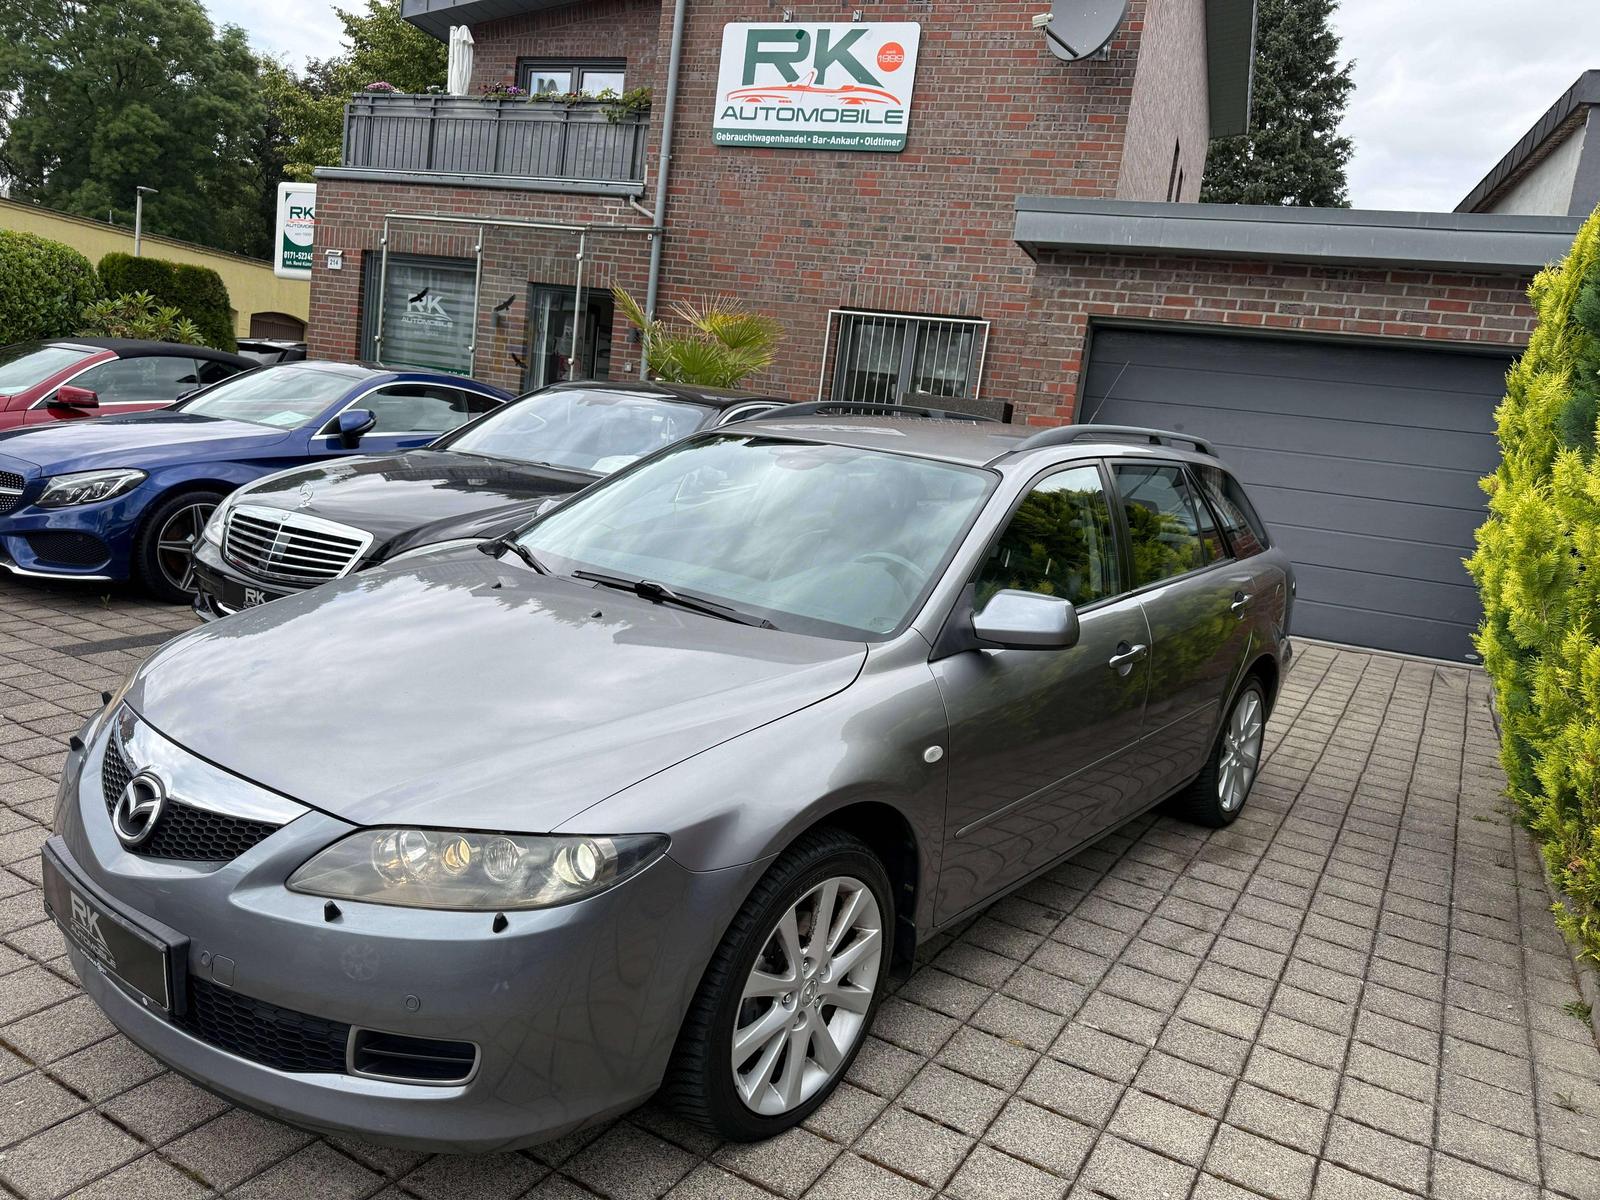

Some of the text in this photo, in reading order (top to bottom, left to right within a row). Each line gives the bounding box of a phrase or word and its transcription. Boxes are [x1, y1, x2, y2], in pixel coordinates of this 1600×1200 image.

[741, 28, 884, 88] RK
[878, 54, 904, 63] 1999
[720, 106, 904, 125] AUTOMOBILE
[716, 132, 901, 147] Gebrauchtwagenhandel Bar-Ankauf Oldtimer
[289, 206, 315, 219] RK
[407, 293, 448, 317] RK
[401, 316, 454, 328] AUTOMOBILE
[245, 587, 266, 605] RK
[70, 890, 109, 949] RK
